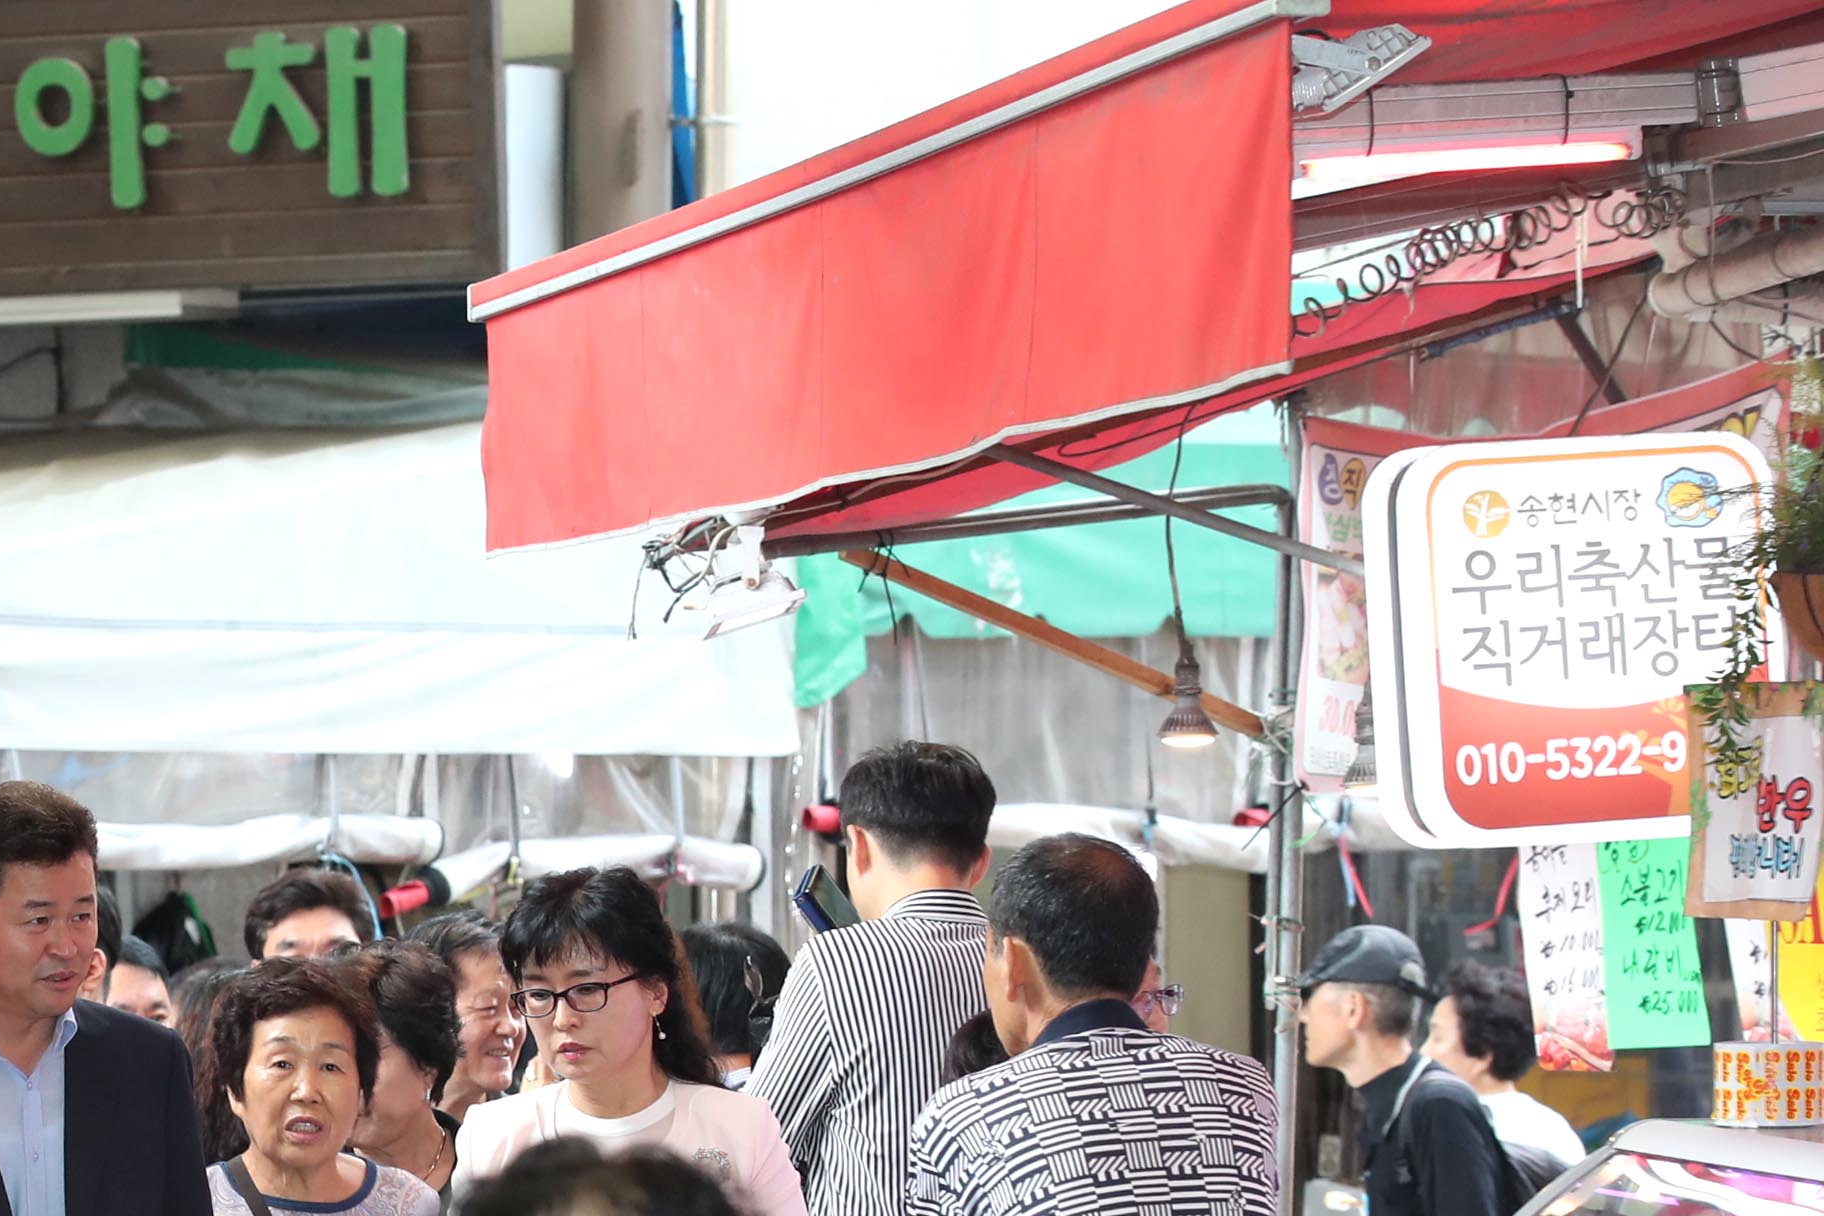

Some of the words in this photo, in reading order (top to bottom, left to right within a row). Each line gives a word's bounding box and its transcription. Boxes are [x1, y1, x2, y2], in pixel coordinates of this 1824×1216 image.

[14, 23, 409, 209] 야채
[1517, 488, 1643, 528] 송현시장
[1451, 536, 1736, 615] 우리축산물
[1461, 604, 1738, 687] 직거래장터
